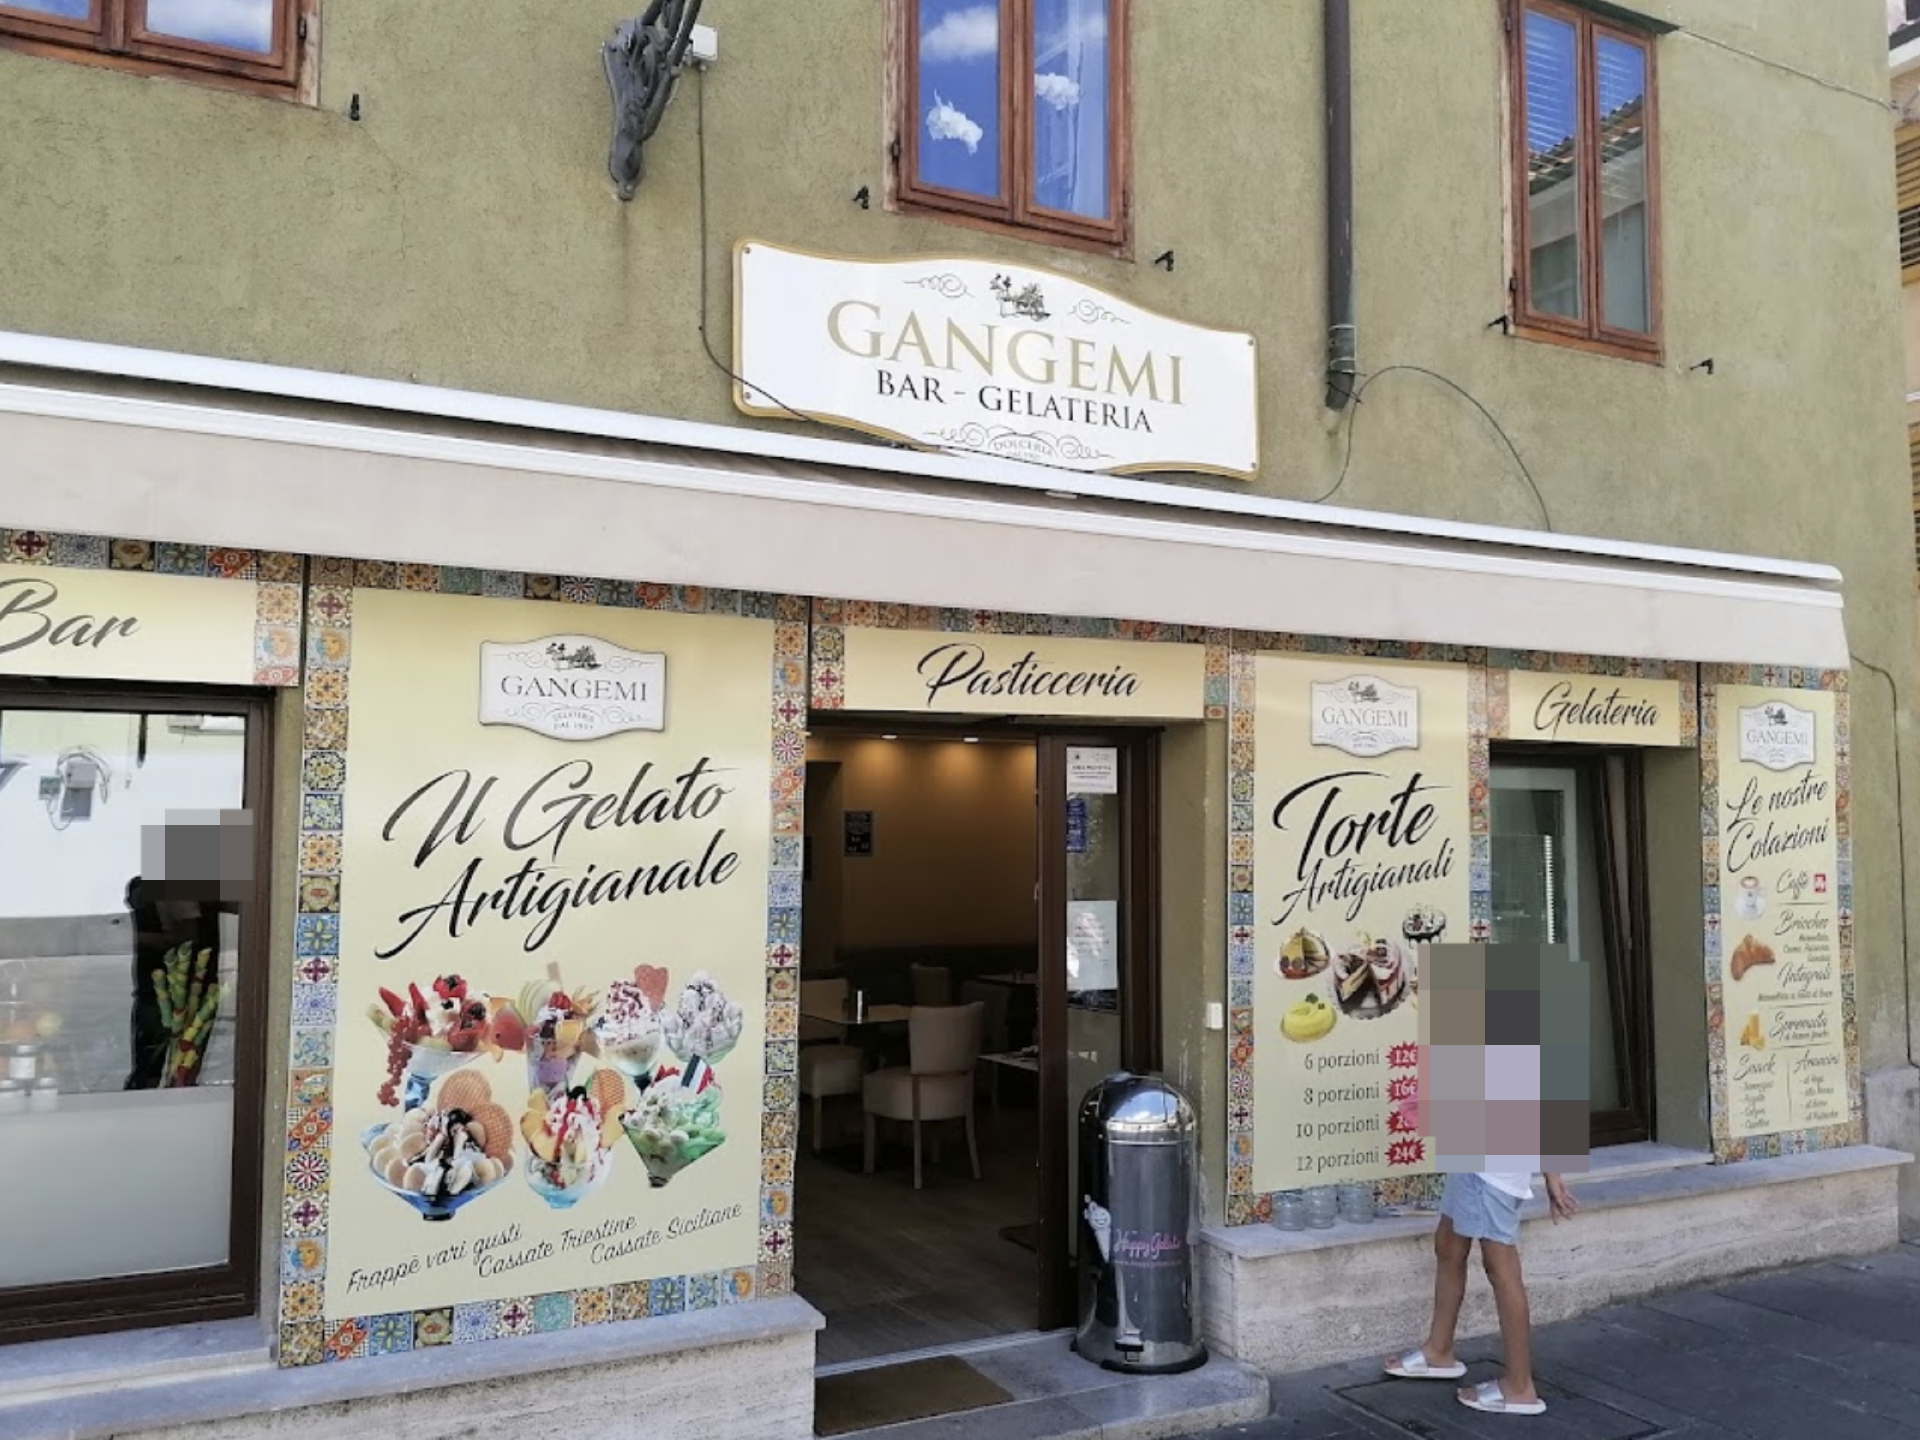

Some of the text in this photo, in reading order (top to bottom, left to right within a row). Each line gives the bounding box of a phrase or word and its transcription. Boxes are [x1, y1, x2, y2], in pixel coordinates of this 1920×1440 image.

[826, 299, 1184, 405] GANGEMI
[876, 368, 946, 405] BAR
[978, 384, 1153, 433] GELATERIA
[0, 577, 140, 655] Bar
[501, 675, 647, 701] GANGEMI
[917, 642, 1143, 709] Pasticceria
[1321, 706, 1409, 728] GANGEMI
[1534, 680, 1661, 742] Gelateria
[1746, 729, 1808, 746] GANGEMI
[382, 757, 742, 868] Il Gelato
[1272, 770, 1453, 882] Torte
[1726, 769, 1829, 832] Le nostre
[1726, 818, 1830, 873] Colazioni
[374, 828, 742, 960] Artigianale
[1270, 838, 1454, 926] Artigianali
[1304, 1052, 1314, 1071] 6
[1317, 1048, 1380, 1073] porzioni
[1303, 1087, 1314, 1105] 8
[1317, 1082, 1380, 1107] porzioni
[1296, 1122, 1313, 1139] 10
[1317, 1114, 1380, 1141] porzioni
[1297, 1155, 1313, 1171] 12
[1317, 1147, 1380, 1173] porzioni
[426, 1240, 467, 1268] vari
[473, 1223, 523, 1266] gusti
[478, 1214, 638, 1279] Cassate Triestine
[590, 1202, 743, 1265] Cassate Siciliane
